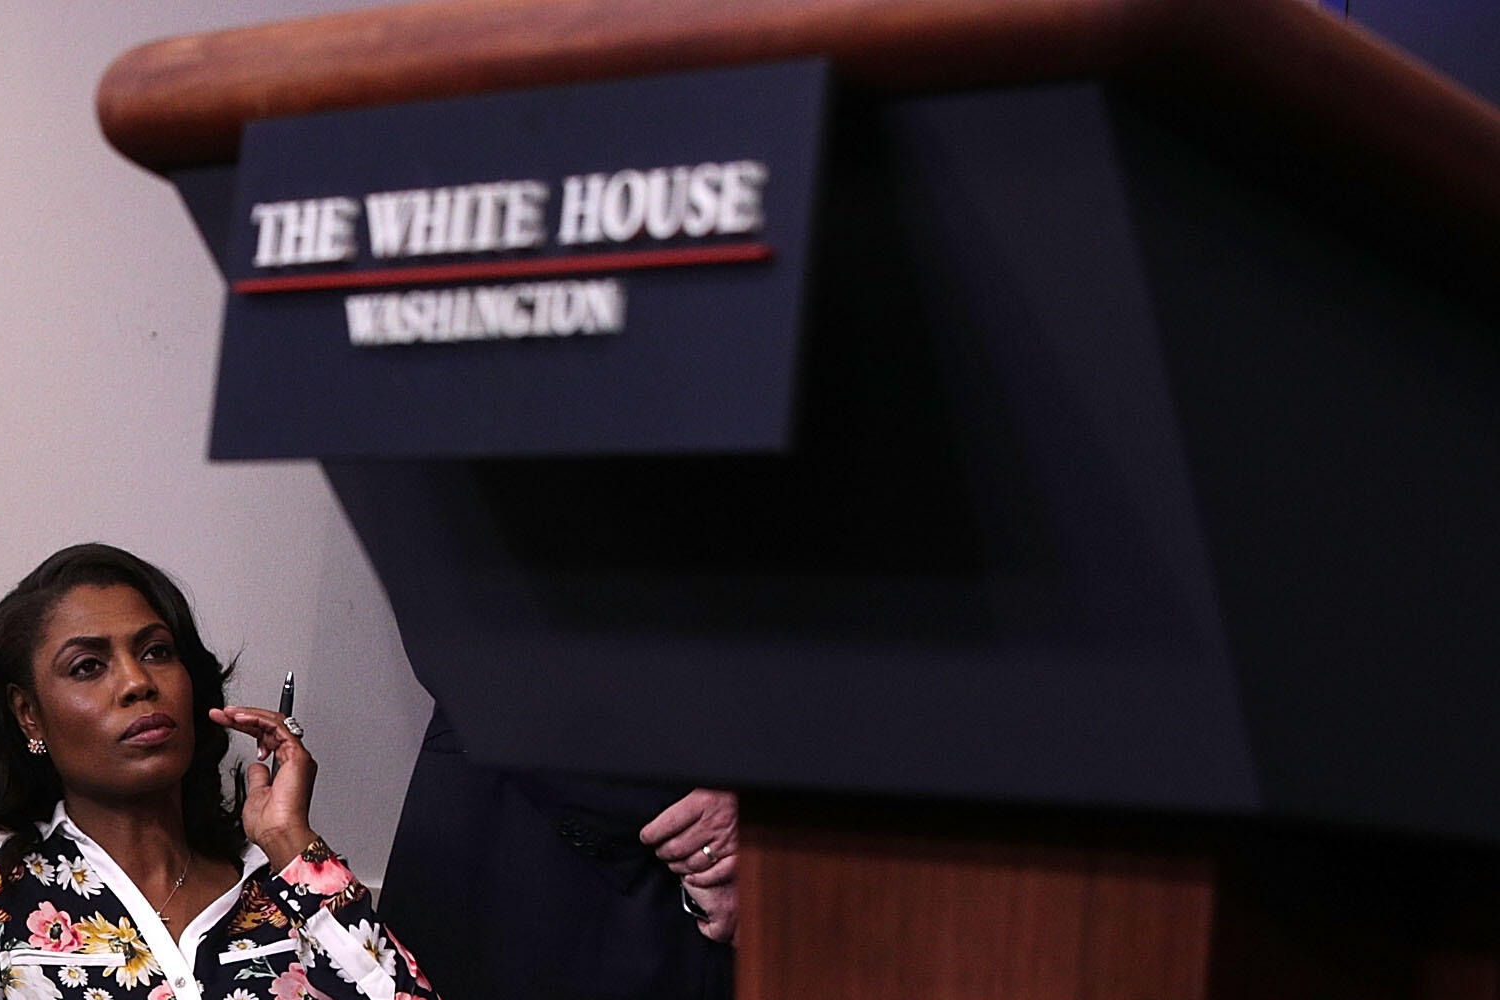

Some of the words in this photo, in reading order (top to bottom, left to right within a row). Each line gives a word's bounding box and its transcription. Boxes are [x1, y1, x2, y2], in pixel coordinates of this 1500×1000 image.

[251, 197, 359, 268] THE
[365, 180, 550, 259] WHITE
[558, 160, 768, 245] HOUSE
[345, 280, 625, 346] WASHINGTON
